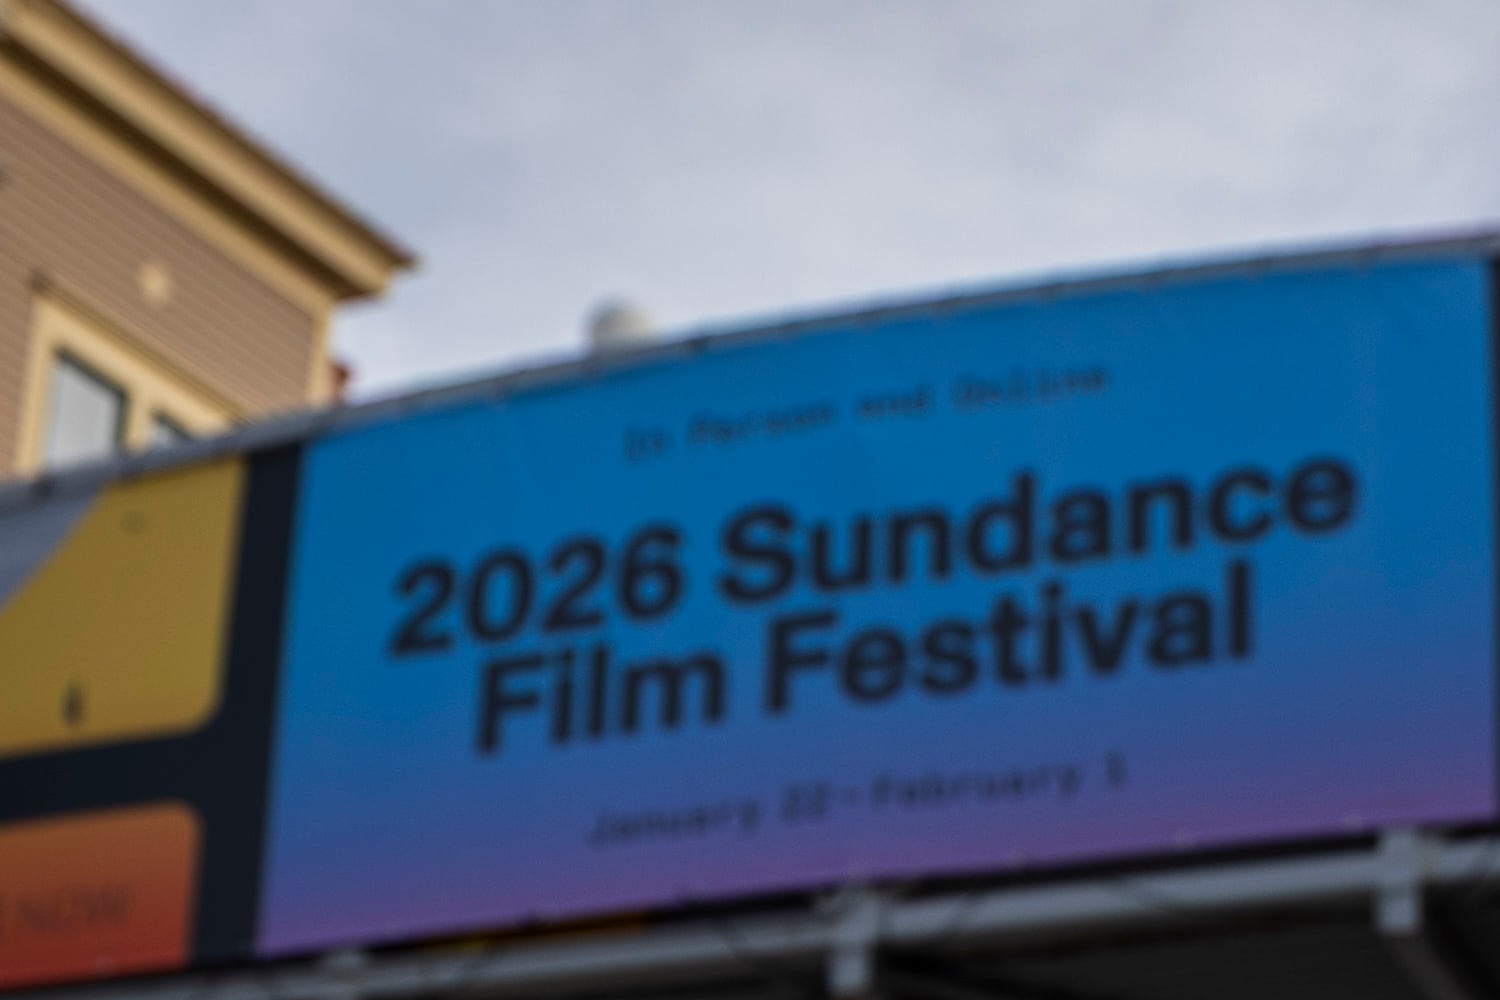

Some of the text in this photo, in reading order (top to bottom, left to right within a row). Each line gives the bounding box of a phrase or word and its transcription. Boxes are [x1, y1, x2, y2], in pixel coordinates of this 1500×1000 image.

[390, 460, 1357, 656] 2026 Sundance
[477, 557, 1252, 755] Film Festival
